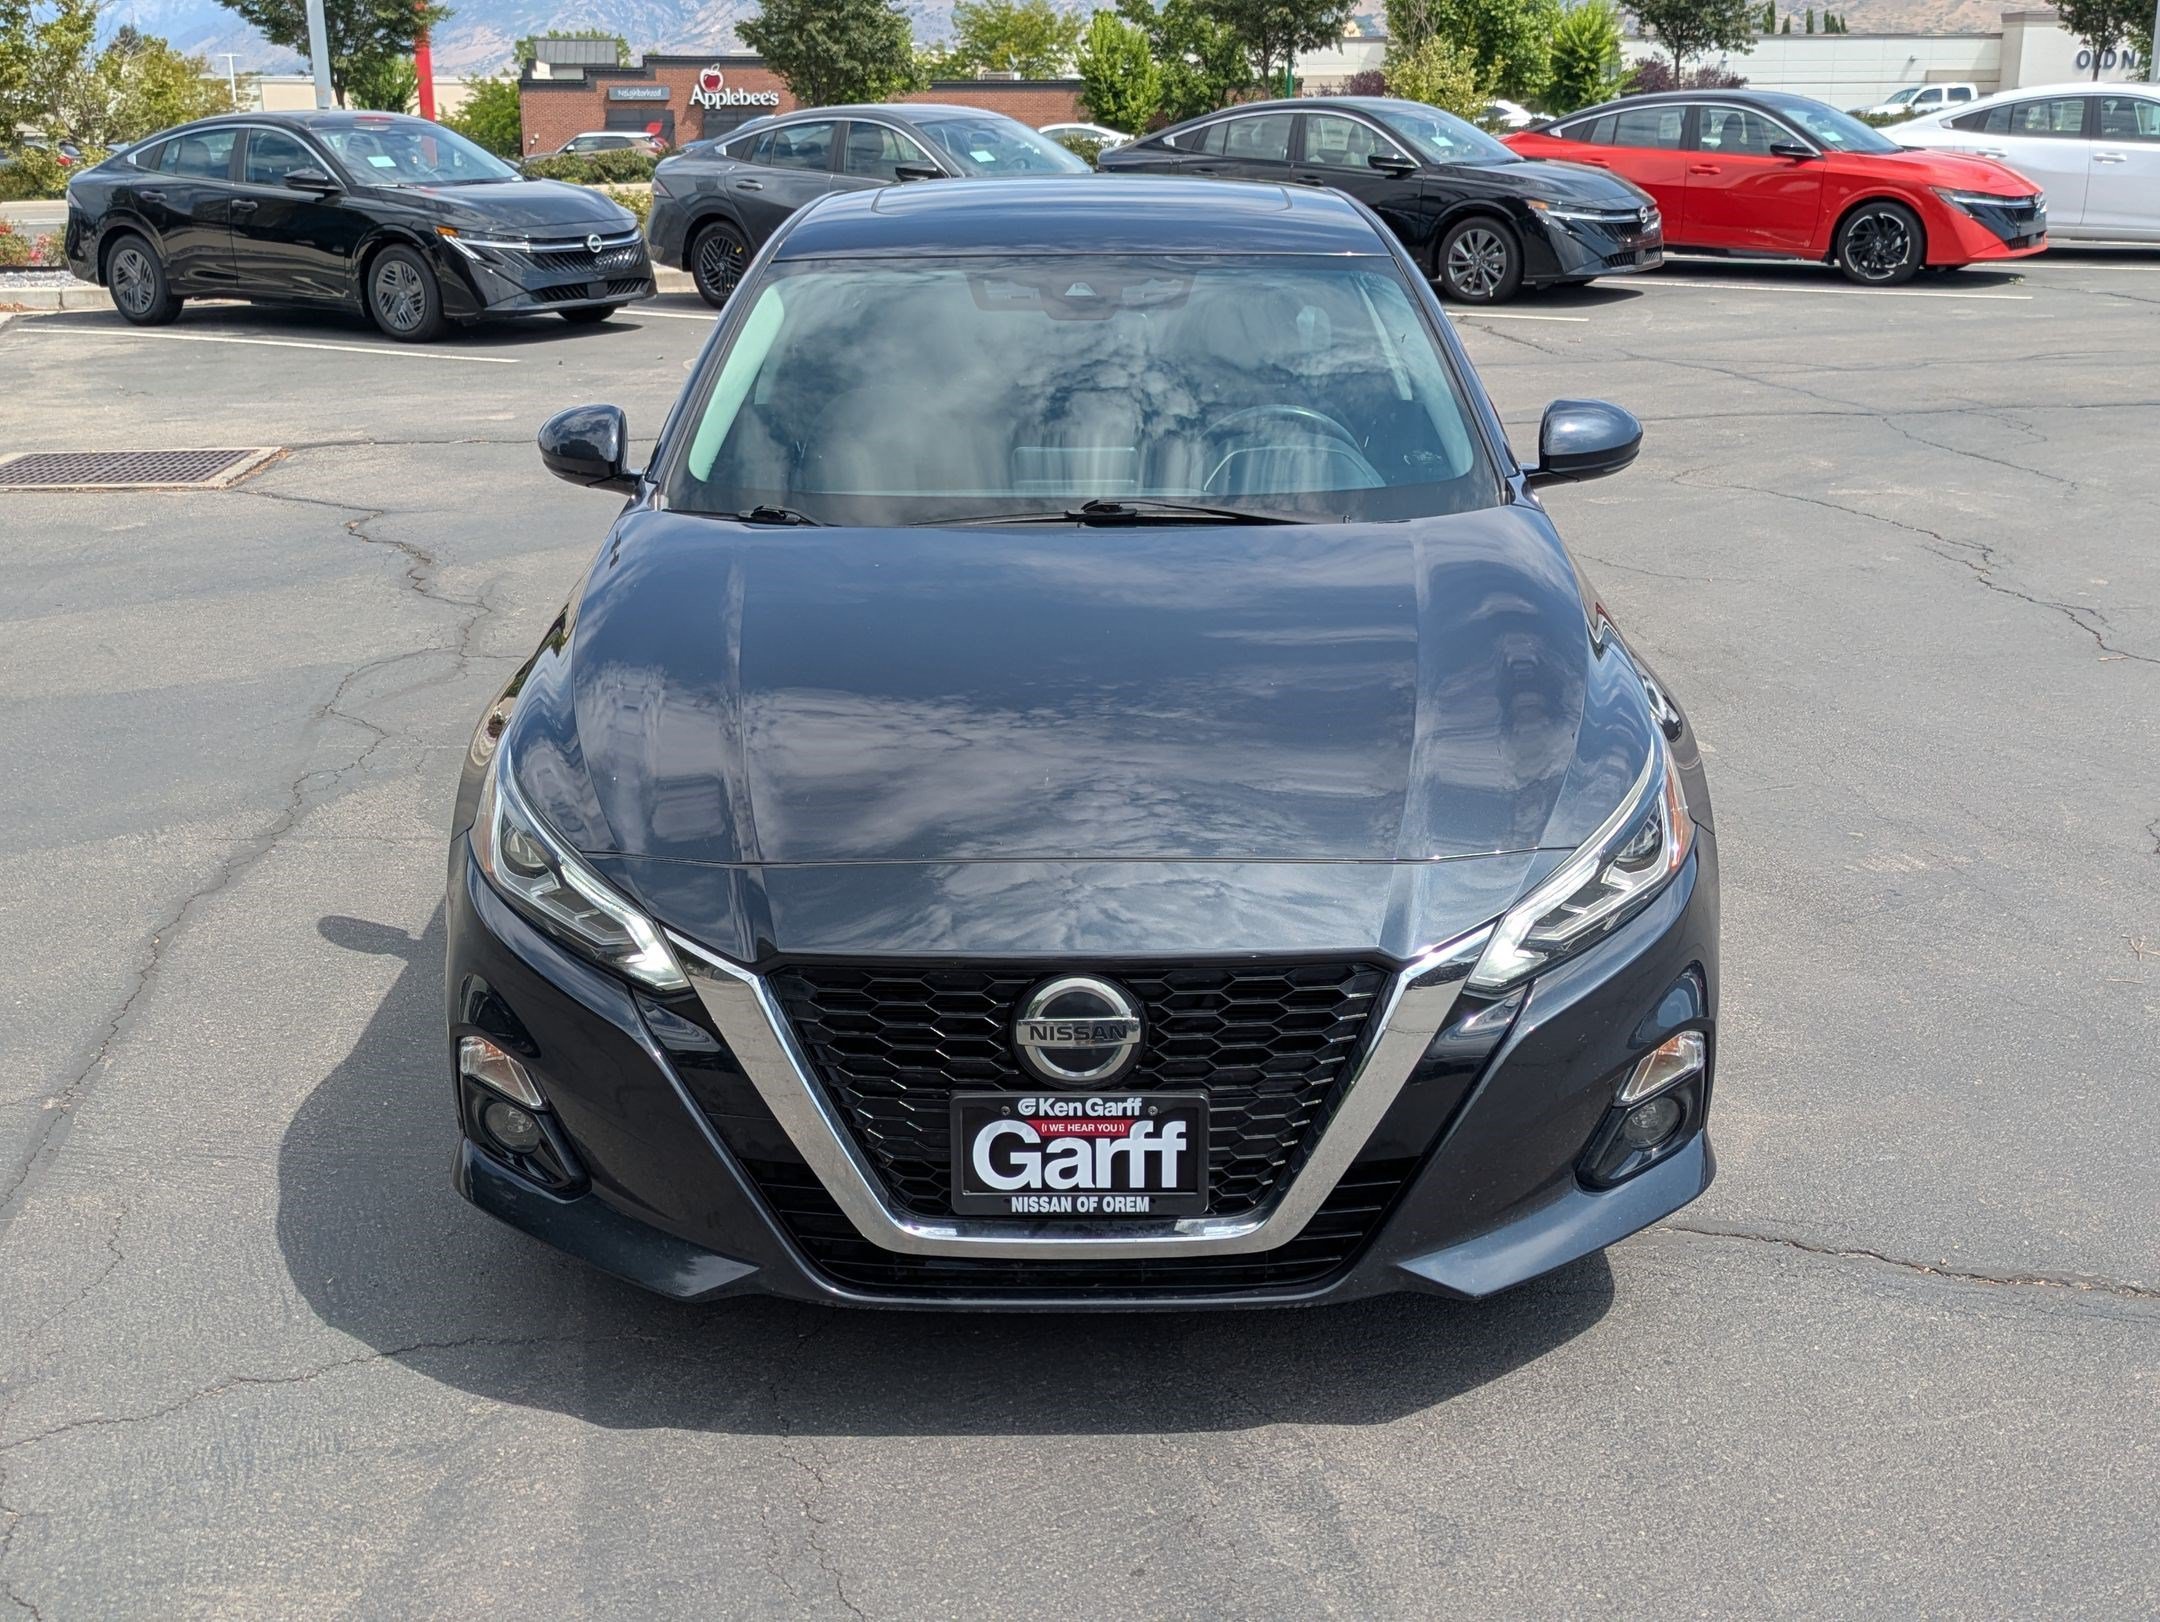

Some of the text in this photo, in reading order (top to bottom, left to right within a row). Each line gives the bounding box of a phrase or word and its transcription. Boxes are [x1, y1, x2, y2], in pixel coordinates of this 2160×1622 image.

[2076, 50, 2117, 70] OD
[689, 84, 779, 109] Applebee's
[1029, 1026, 1127, 1041] NISSAN
[1039, 1098, 1142, 1117] Ken Garff
[1049, 1124, 1118, 1132] WE HEAR YOU
[972, 1119, 1187, 1190] Garff
[1011, 1196, 1150, 1212] NISSAN OF OREM
